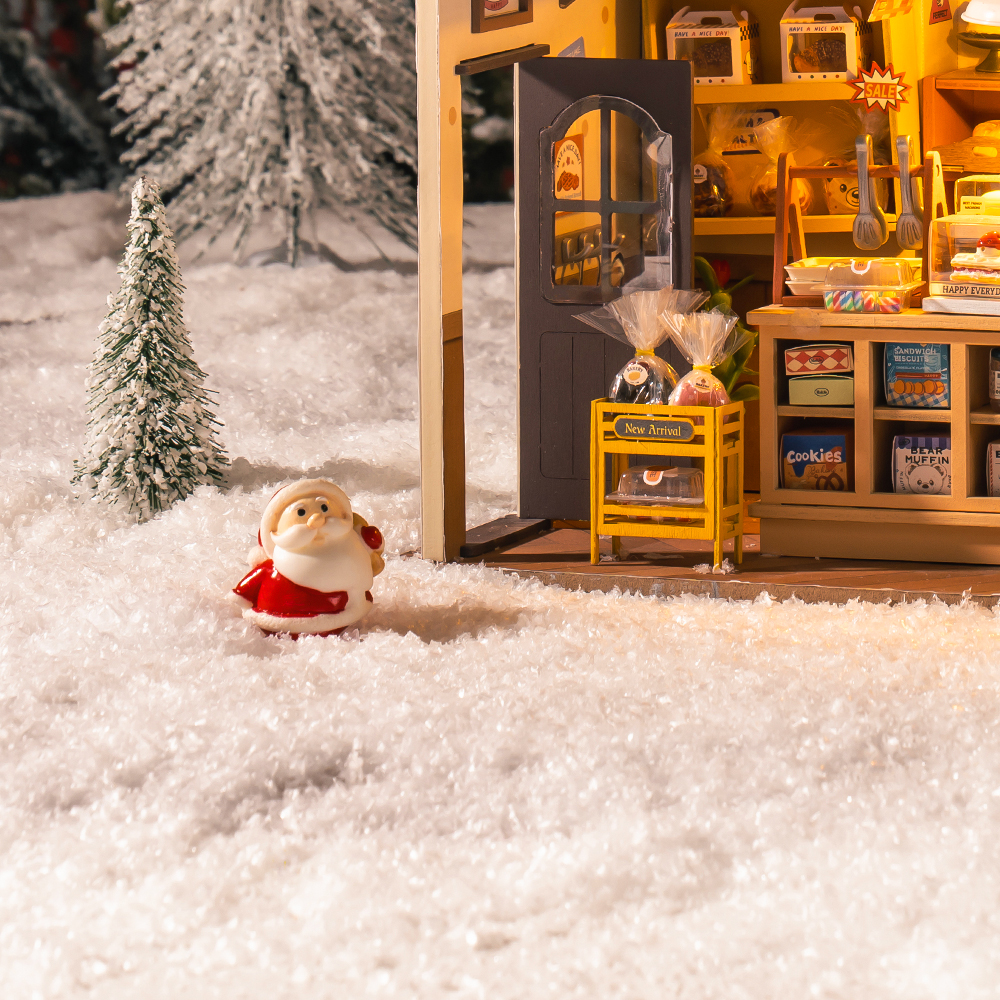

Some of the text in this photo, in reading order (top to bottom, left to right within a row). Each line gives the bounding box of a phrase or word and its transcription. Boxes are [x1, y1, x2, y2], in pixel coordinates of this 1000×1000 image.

[865, 83, 896, 98] SALE
[942, 285, 969, 295] HAPPY
[894, 346, 937, 355] SANDWICH
[894, 355, 930, 363] BISCUITS
[625, 422, 681, 437] New Arrival
[786, 448, 842, 463] Cookies
[911, 446, 943, 455] BEAR
[905, 455, 949, 465] MUFFIN
